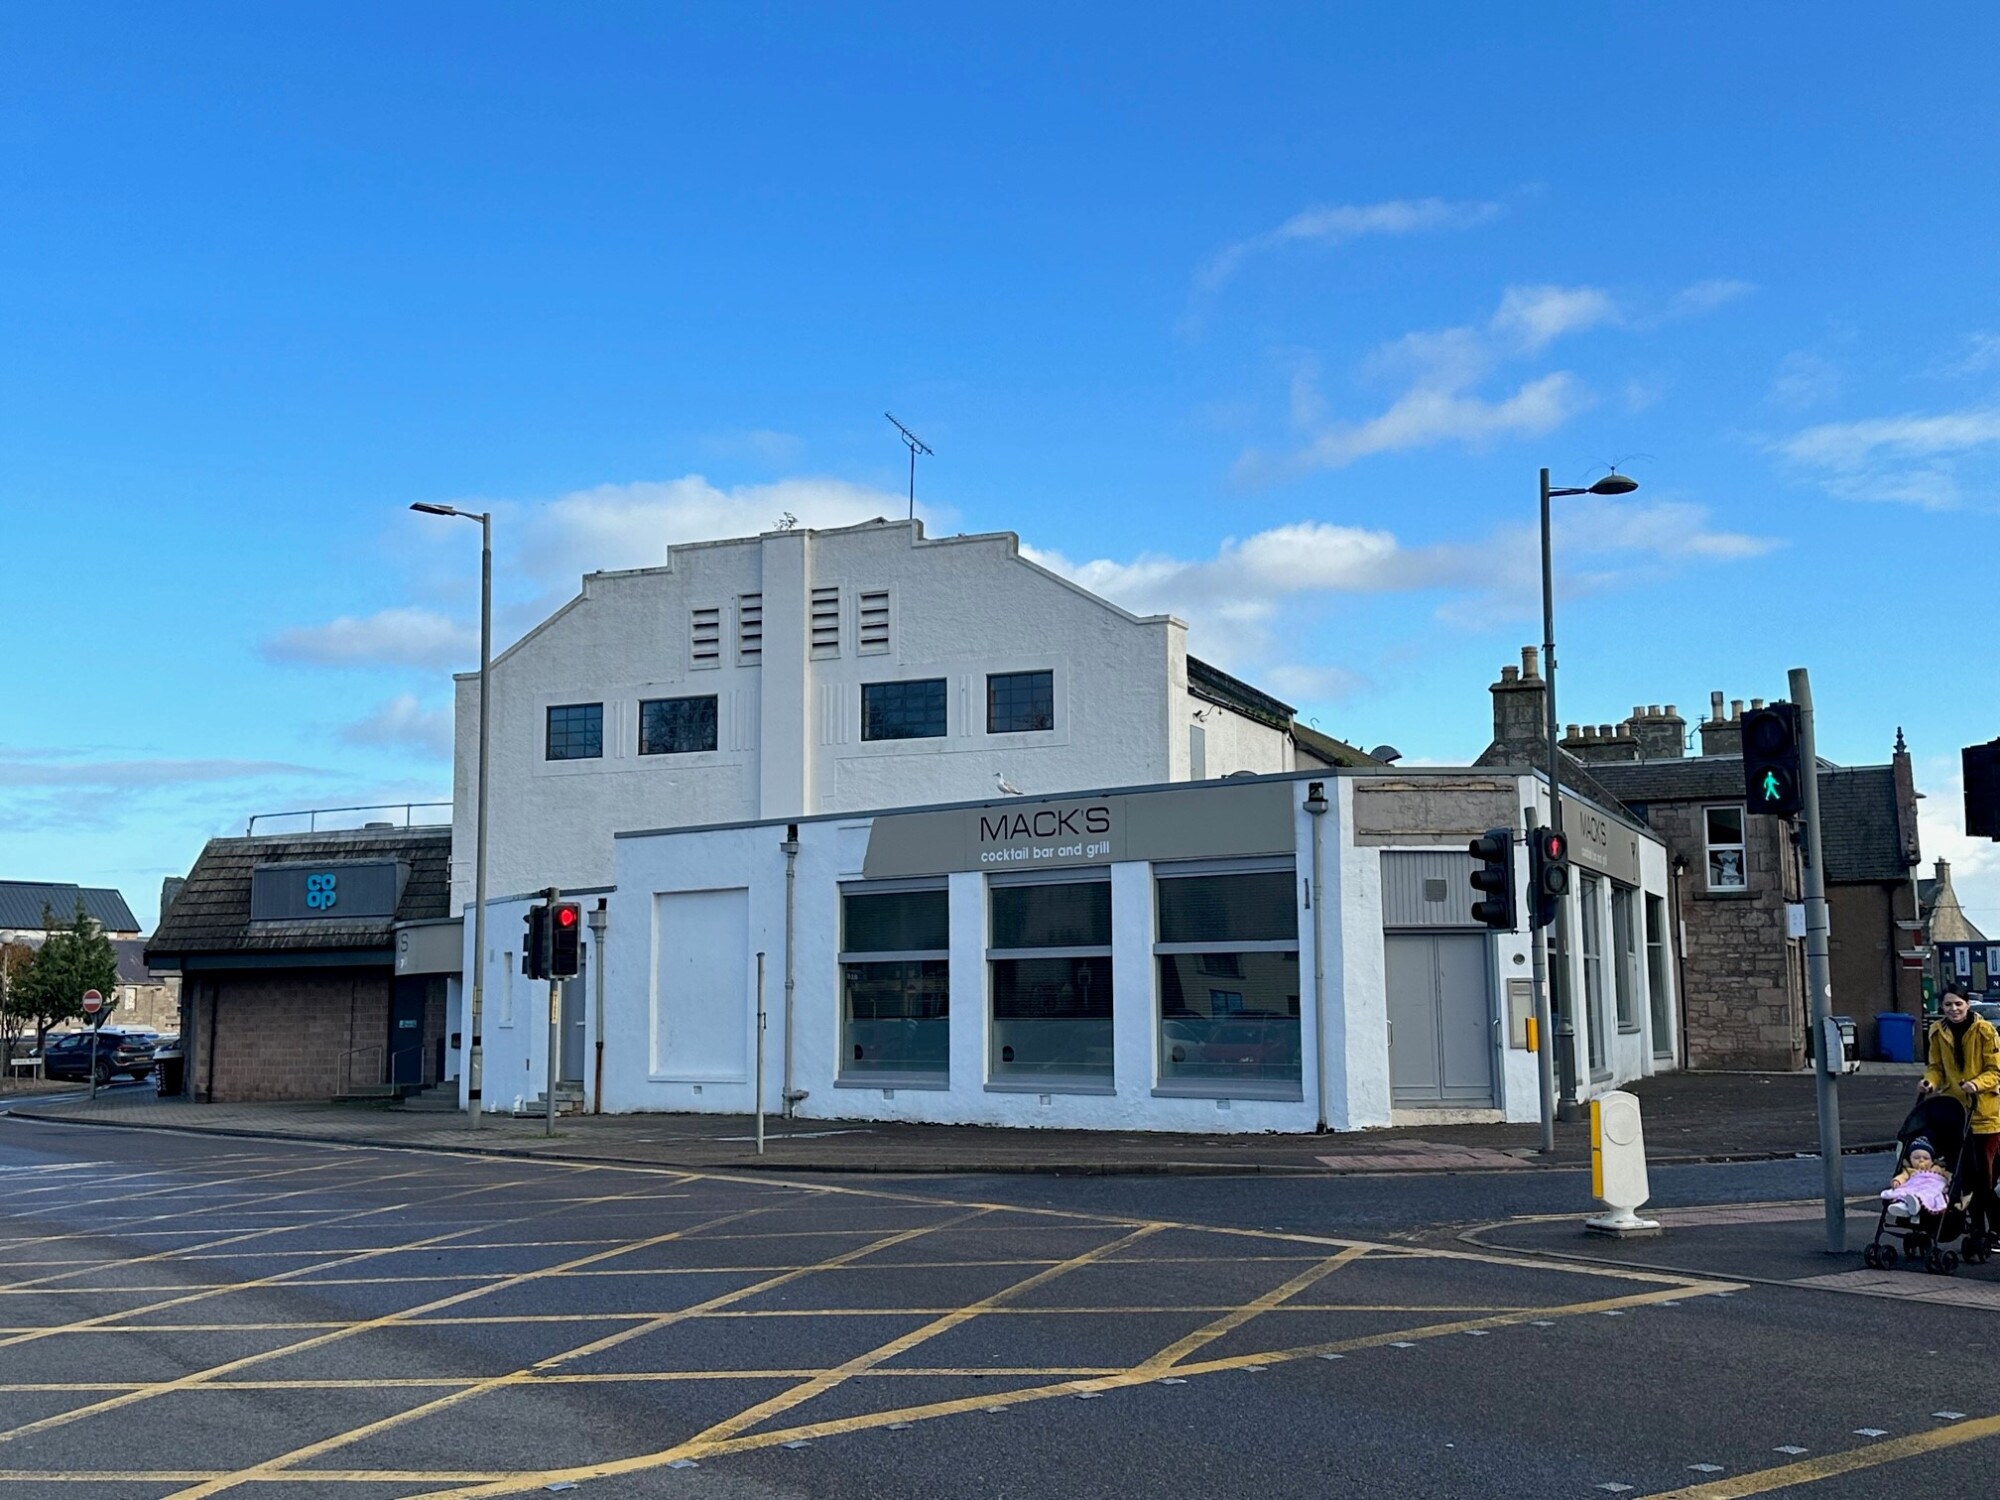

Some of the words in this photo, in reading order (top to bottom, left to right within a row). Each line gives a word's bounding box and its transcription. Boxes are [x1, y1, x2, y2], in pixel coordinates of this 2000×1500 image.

[980, 806, 1110, 842] MACK'S
[981, 847, 1029, 862] cocktail
[1033, 846, 1054, 858] bar
[1058, 843, 1081, 857] and
[1086, 841, 1110, 858] grill
